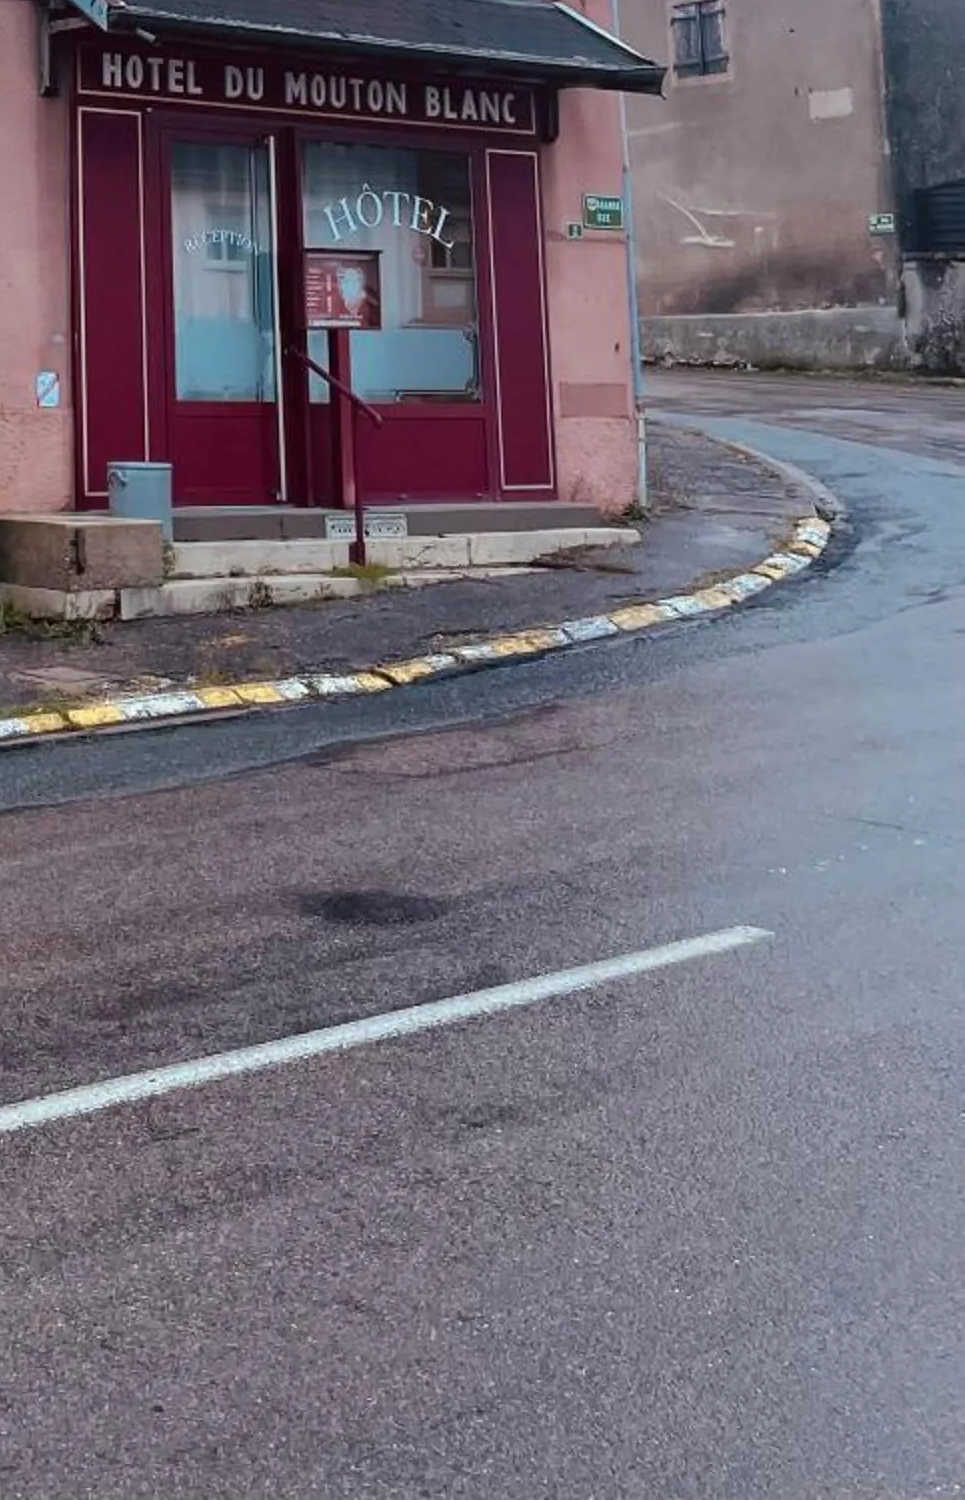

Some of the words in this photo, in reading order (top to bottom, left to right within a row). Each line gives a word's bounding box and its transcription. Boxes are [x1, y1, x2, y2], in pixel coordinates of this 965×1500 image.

[102, 52, 203, 95] HOTEL
[225, 66, 265, 100] DU
[284, 73, 408, 115] MOUTON
[425, 86, 517, 124] BLANC
[323, 183, 456, 249] HÔTEL
